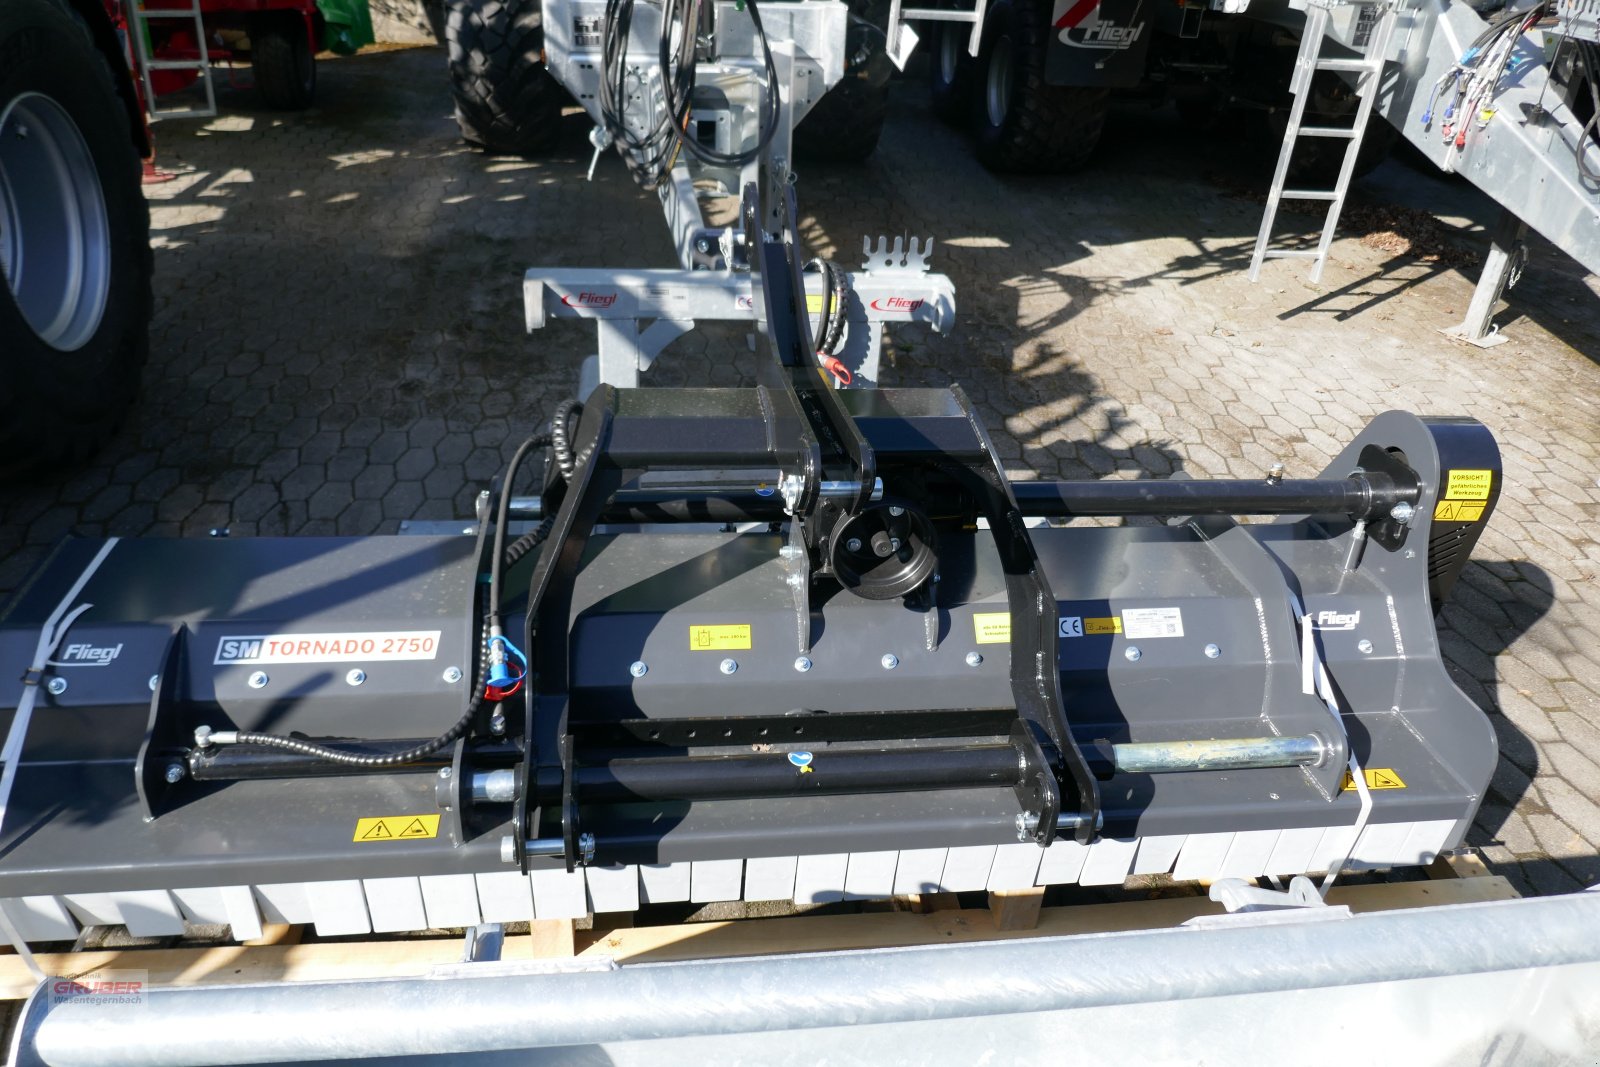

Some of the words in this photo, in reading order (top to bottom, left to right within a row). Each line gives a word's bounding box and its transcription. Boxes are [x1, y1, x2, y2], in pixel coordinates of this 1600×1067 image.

[1083, 21, 1145, 45] Fliegl
[578, 292, 617, 307] Fliegl
[886, 297, 924, 311] Fliegl
[1317, 610, 1360, 628] Fliegl
[63, 643, 123, 663] Fliegl
[222, 641, 260, 659] SM
[269, 639, 375, 656] TORNADO
[381, 637, 434, 653] 2750
